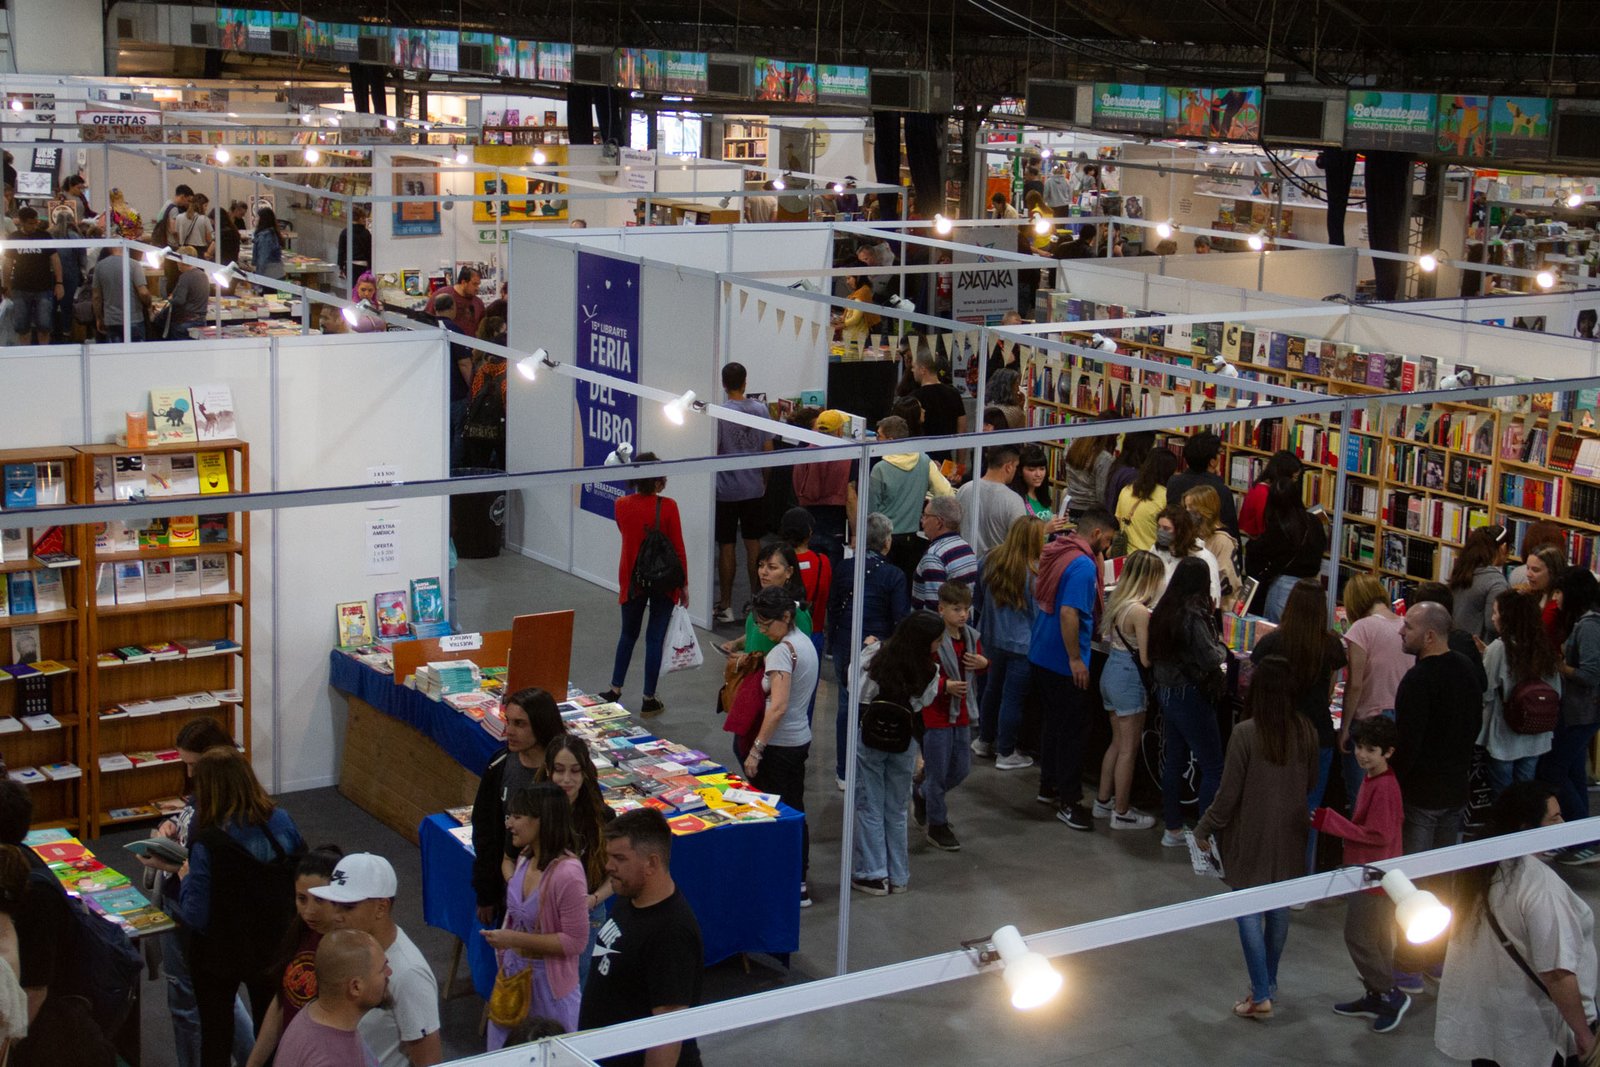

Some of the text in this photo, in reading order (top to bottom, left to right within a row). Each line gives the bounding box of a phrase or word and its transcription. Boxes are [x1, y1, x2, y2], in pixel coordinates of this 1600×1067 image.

[1102, 93, 1161, 113] Berazategui
[93, 115, 147, 125] OFERTAS
[1353, 103, 1428, 124] Berazategui
[98, 125, 110, 134] EL
[1383, 123, 1393, 131] DE
[1394, 123, 1412, 132] ZONA
[1413, 124, 1427, 133] SUR
[600, 323, 628, 339] LIBRARTE
[590, 333, 631, 373] FERIA
[590, 382, 615, 406] DEL
[588, 407, 632, 444] LIBRO
